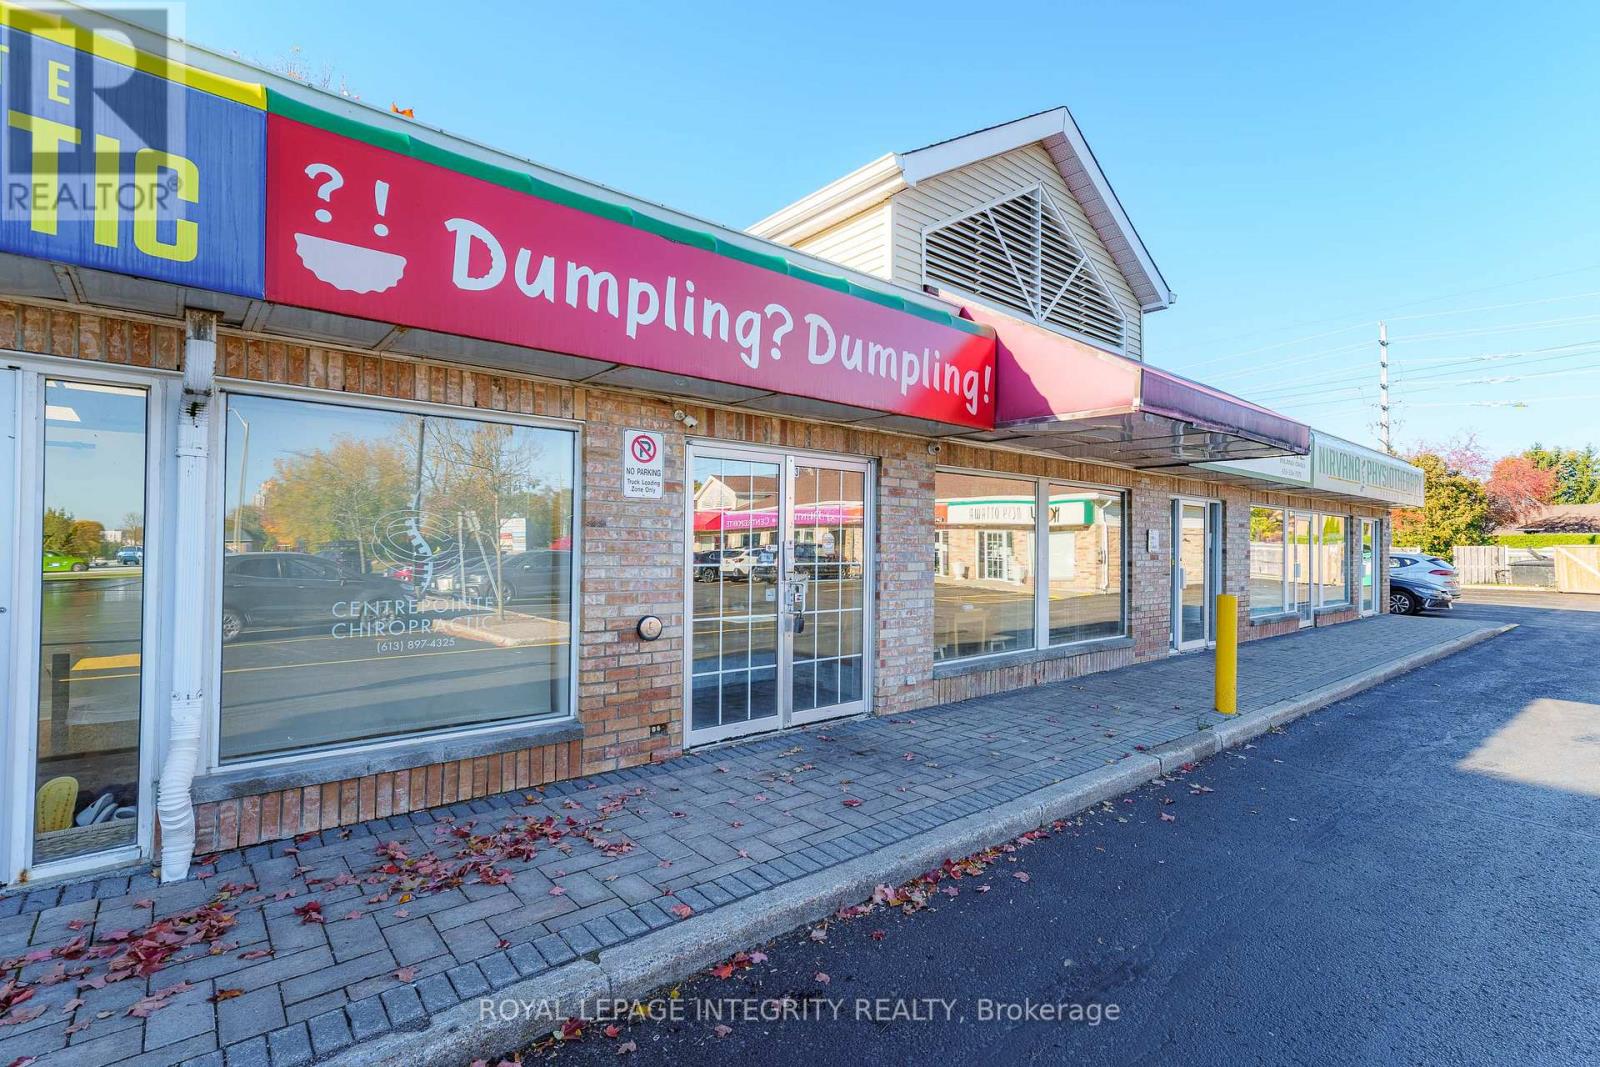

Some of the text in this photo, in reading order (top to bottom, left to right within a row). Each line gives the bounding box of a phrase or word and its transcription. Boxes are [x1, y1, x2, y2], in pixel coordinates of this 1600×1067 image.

[444, 218, 992, 416] Dumpling? Dumpling!
[626, 467, 661, 477] NO PARKING
[1319, 446, 1361, 481] NIRVANA
[627, 478, 660, 488] Truck Loading
[631, 485, 656, 494] Zone Only
[331, 596, 495, 618] CENTREPOINTE
[331, 614, 491, 639] CHIROPRACTIC
[376, 637, 456, 654] (613) 897-4325
